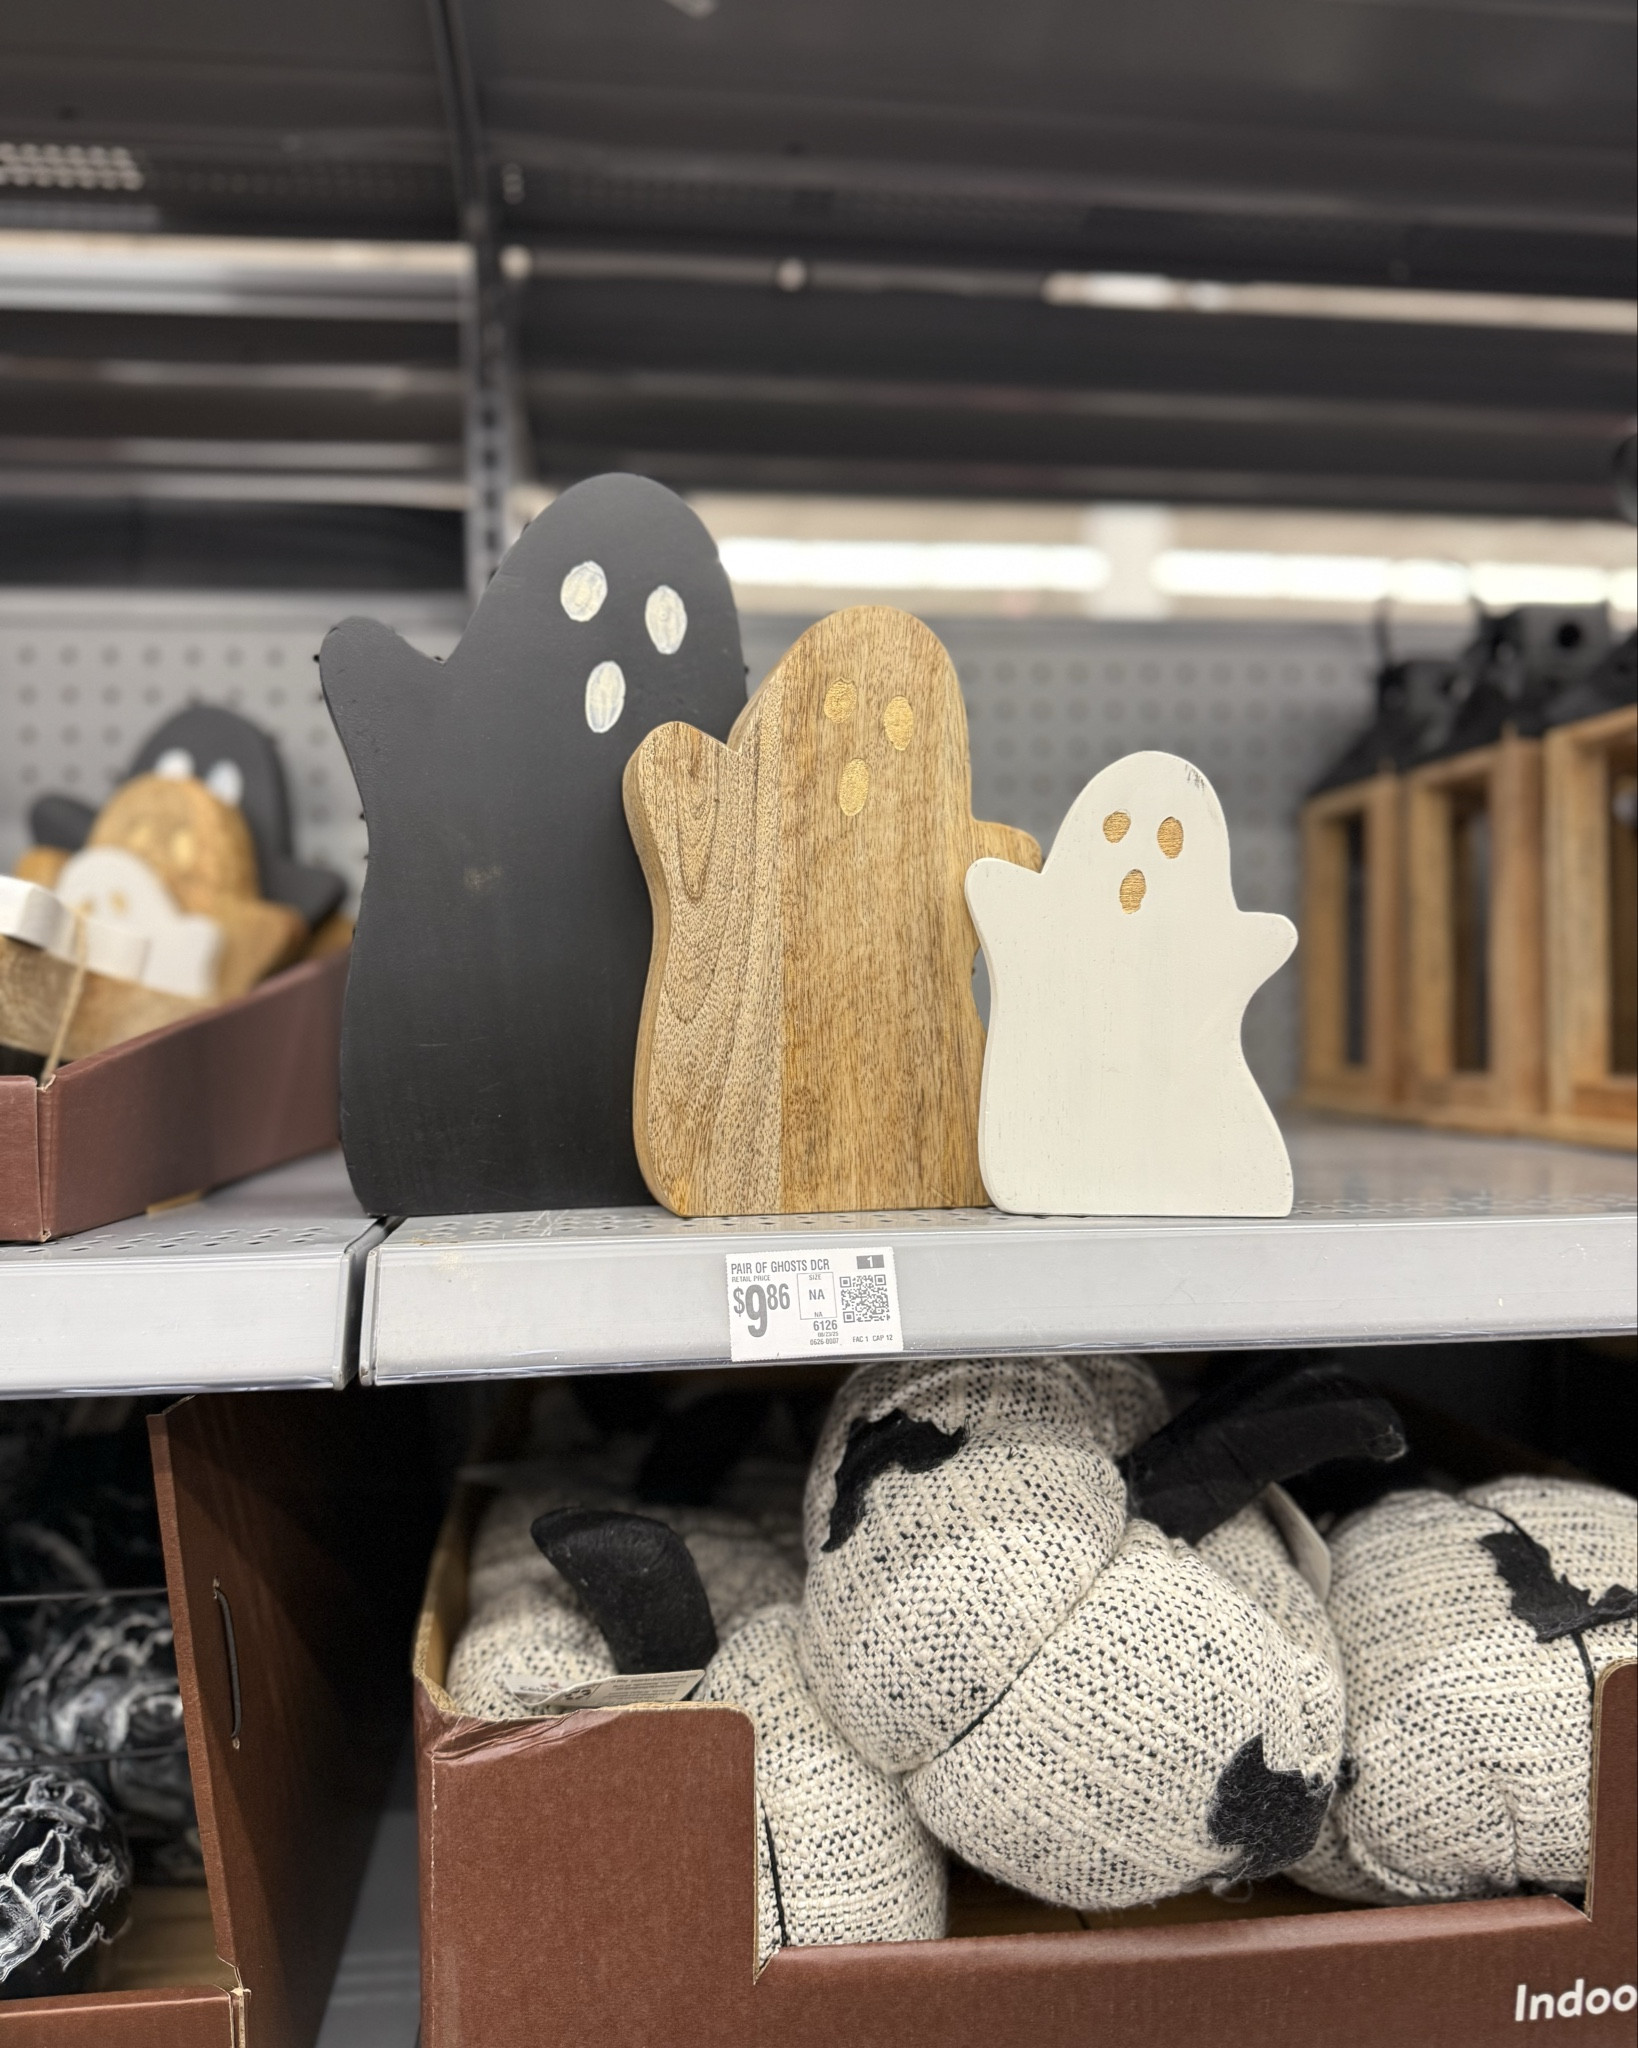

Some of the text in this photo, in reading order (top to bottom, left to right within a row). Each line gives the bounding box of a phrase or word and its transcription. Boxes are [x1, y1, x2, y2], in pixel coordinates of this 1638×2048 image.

[731, 1258, 830, 1275] PAIR OF GHOSTS DCR
[866, 1256, 874, 1268] 1
[731, 1274, 771, 1283] RETAIL PRICE
[808, 1273, 822, 1281] SIZE
[808, 1288, 825, 1301] NA
[813, 1319, 838, 1331] 6126
[852, 1335, 864, 1343] FAC
[872, 1334, 884, 1342] CAP
